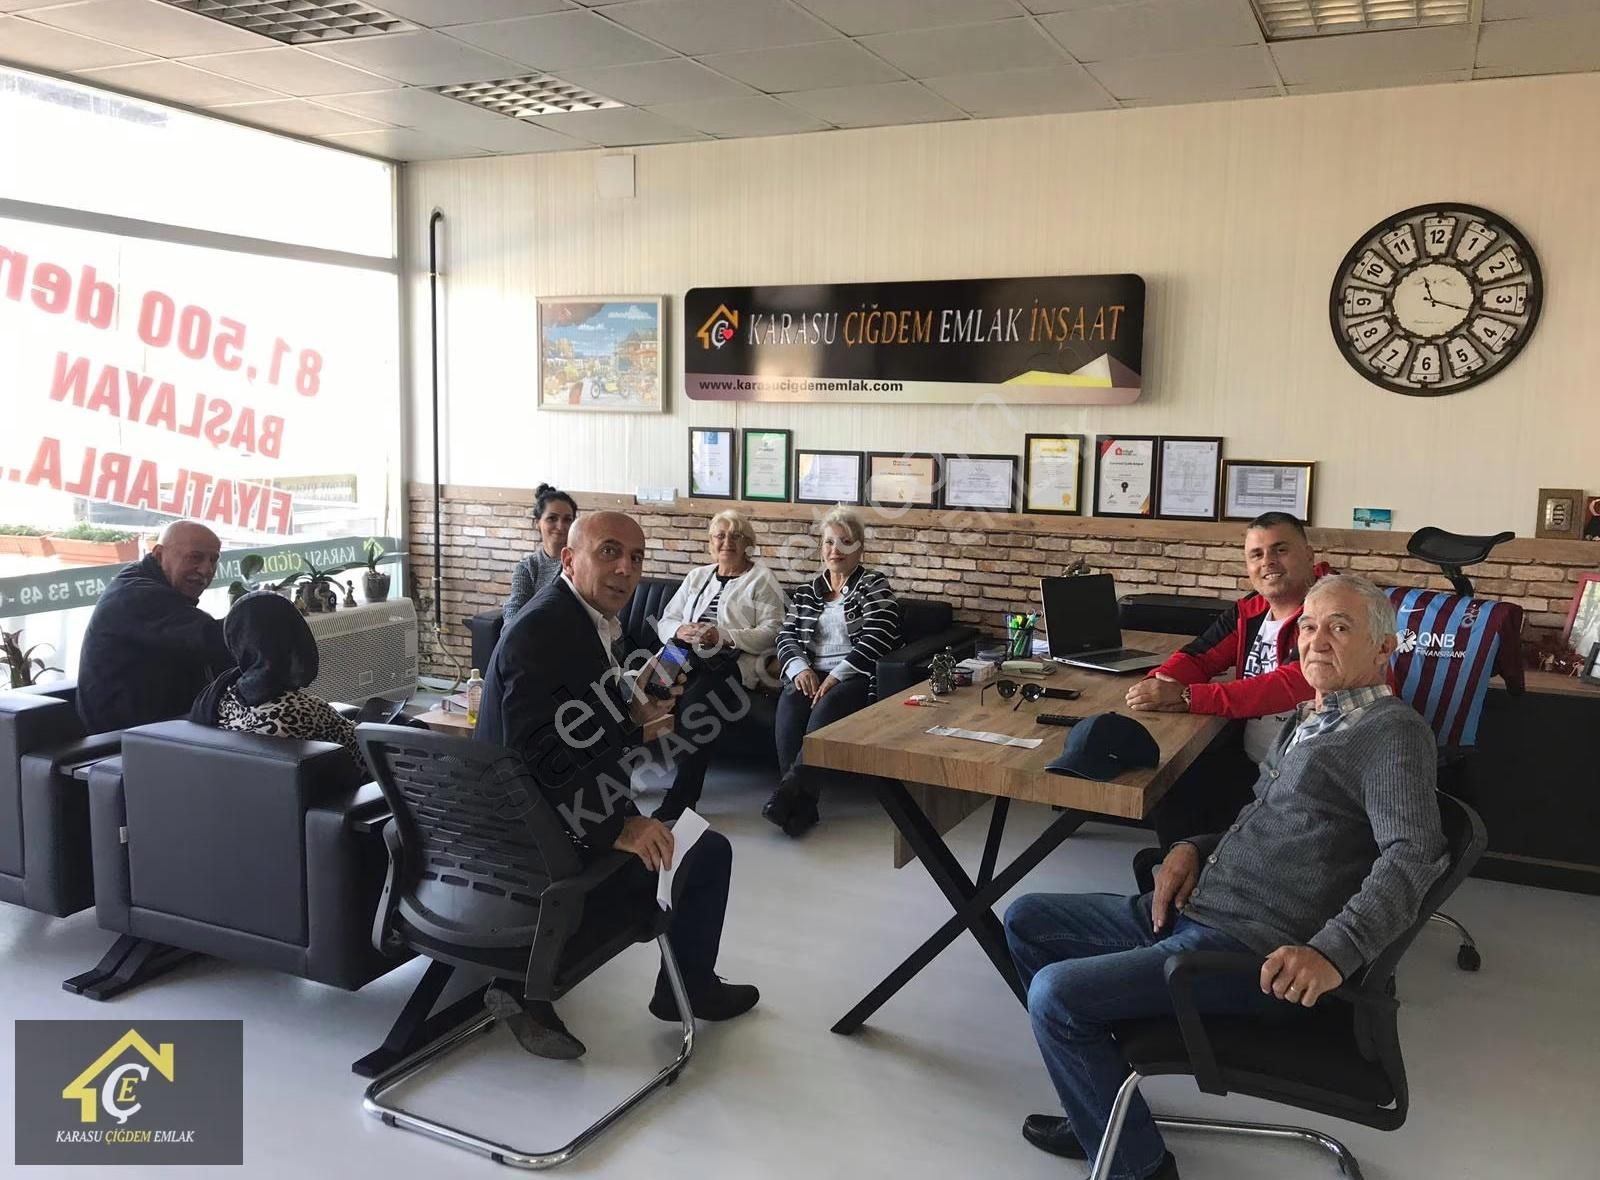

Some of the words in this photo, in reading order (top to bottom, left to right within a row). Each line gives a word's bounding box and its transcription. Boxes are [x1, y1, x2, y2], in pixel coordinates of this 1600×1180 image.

[1429, 229, 1445, 245] 12
[1468, 237, 1479, 251] 1
[1394, 238, 1411, 255] 11
[1367, 263, 1384, 278] 10
[1488, 261, 1506, 273] 2
[1356, 297, 1371, 307] 9
[1496, 295, 1512, 305] 3
[748, 312, 839, 346] KARASU
[843, 303, 934, 349] ÇİĞDEM
[939, 308, 1022, 343] EMLAK
[1029, 298, 1125, 350] İNŞAAT
[1363, 326, 1378, 338] 8
[1483, 326, 1497, 339] 4
[1385, 349, 1399, 362] 7
[1456, 348, 1468, 363] 5
[1421, 356, 1431, 371] 6
[1418, 631, 1456, 648] QNB
